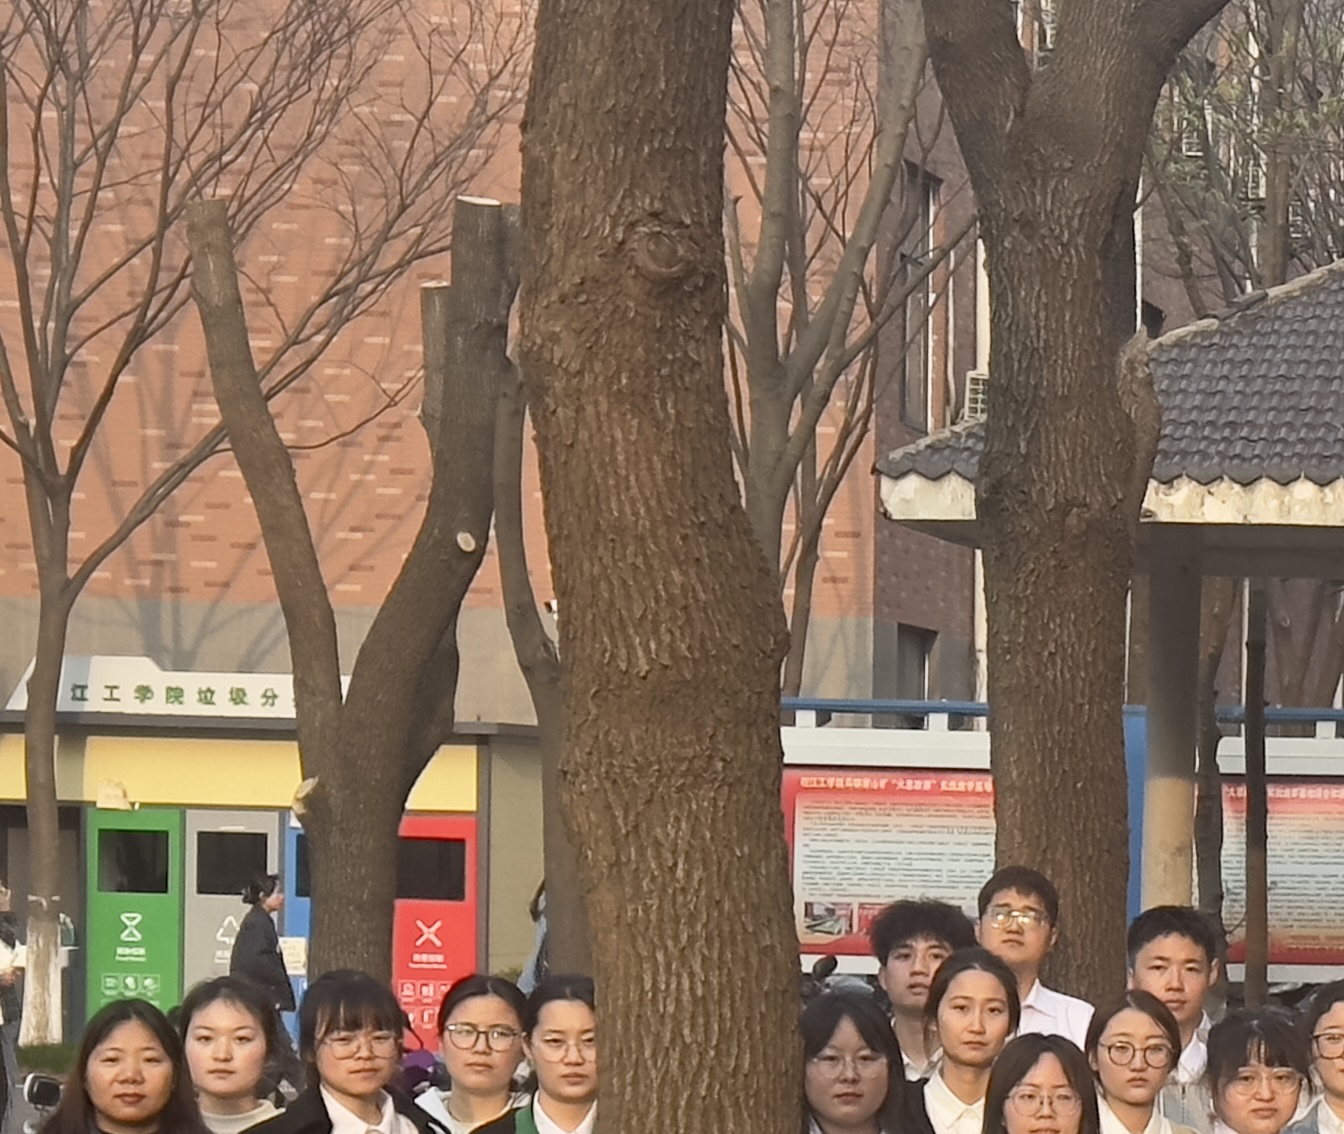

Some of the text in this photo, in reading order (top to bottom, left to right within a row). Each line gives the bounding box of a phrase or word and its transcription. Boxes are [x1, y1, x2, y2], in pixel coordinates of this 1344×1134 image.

[71, 683, 296, 708] 江工学院垃圾分
